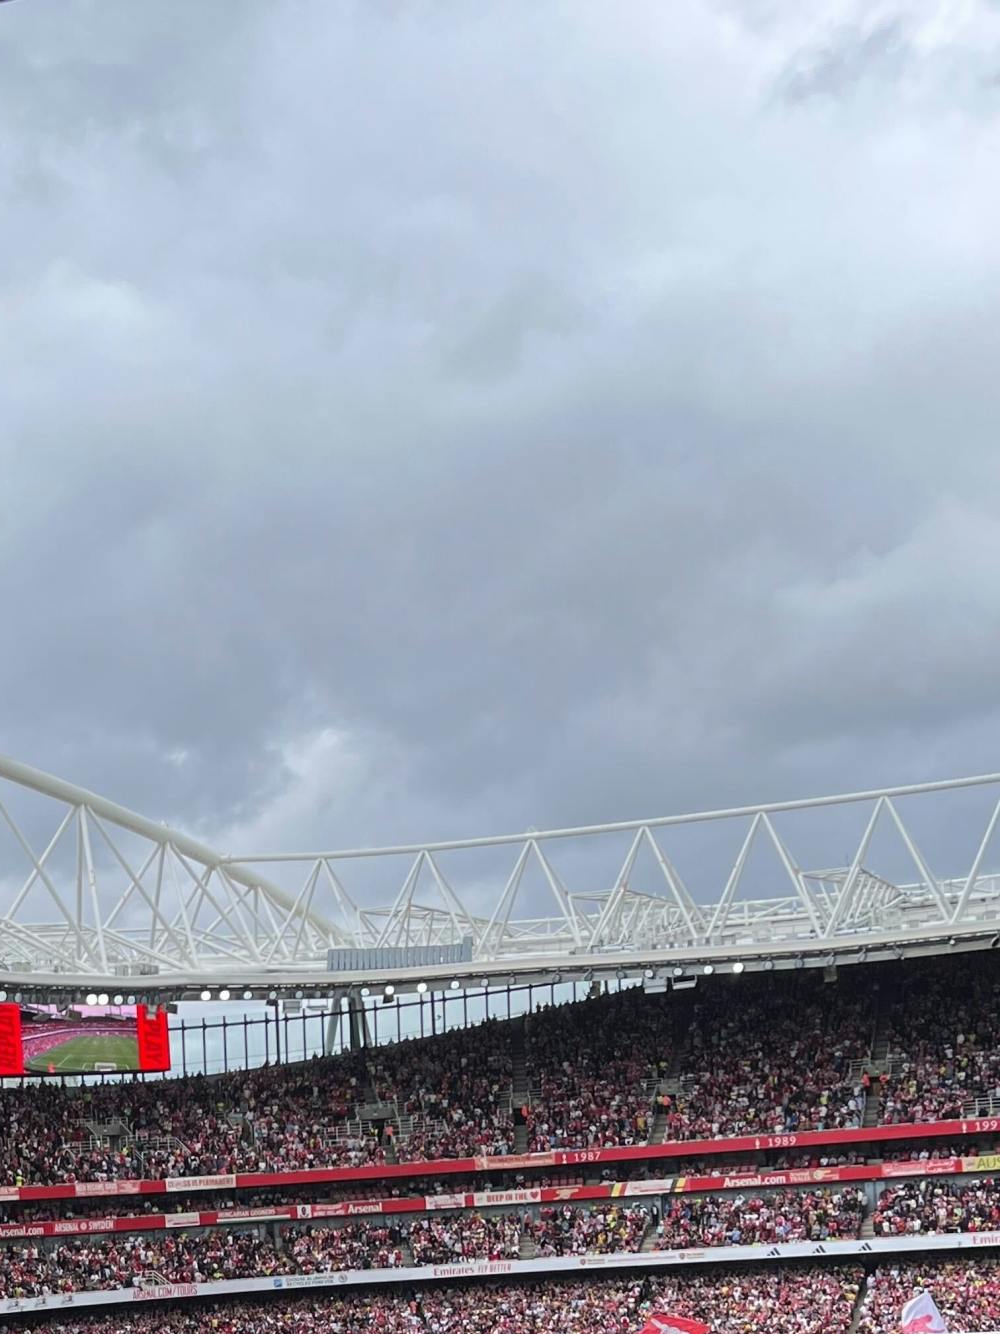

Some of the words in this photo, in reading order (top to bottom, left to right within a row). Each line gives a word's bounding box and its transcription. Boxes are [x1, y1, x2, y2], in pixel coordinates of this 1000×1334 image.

[768, 1136, 796, 1147] 1989
[574, 1151, 600, 1162] 1987
[723, 1174, 786, 1188] Arsenal.com
[347, 1202, 382, 1215] Arsenal
[54, 1222, 79, 1233] ARSENAL
[88, 1219, 114, 1231] SWEDEN
[433, 1265, 475, 1278] Emirates
[132, 1284, 198, 1300] ARSENAL.COM/TOURS
